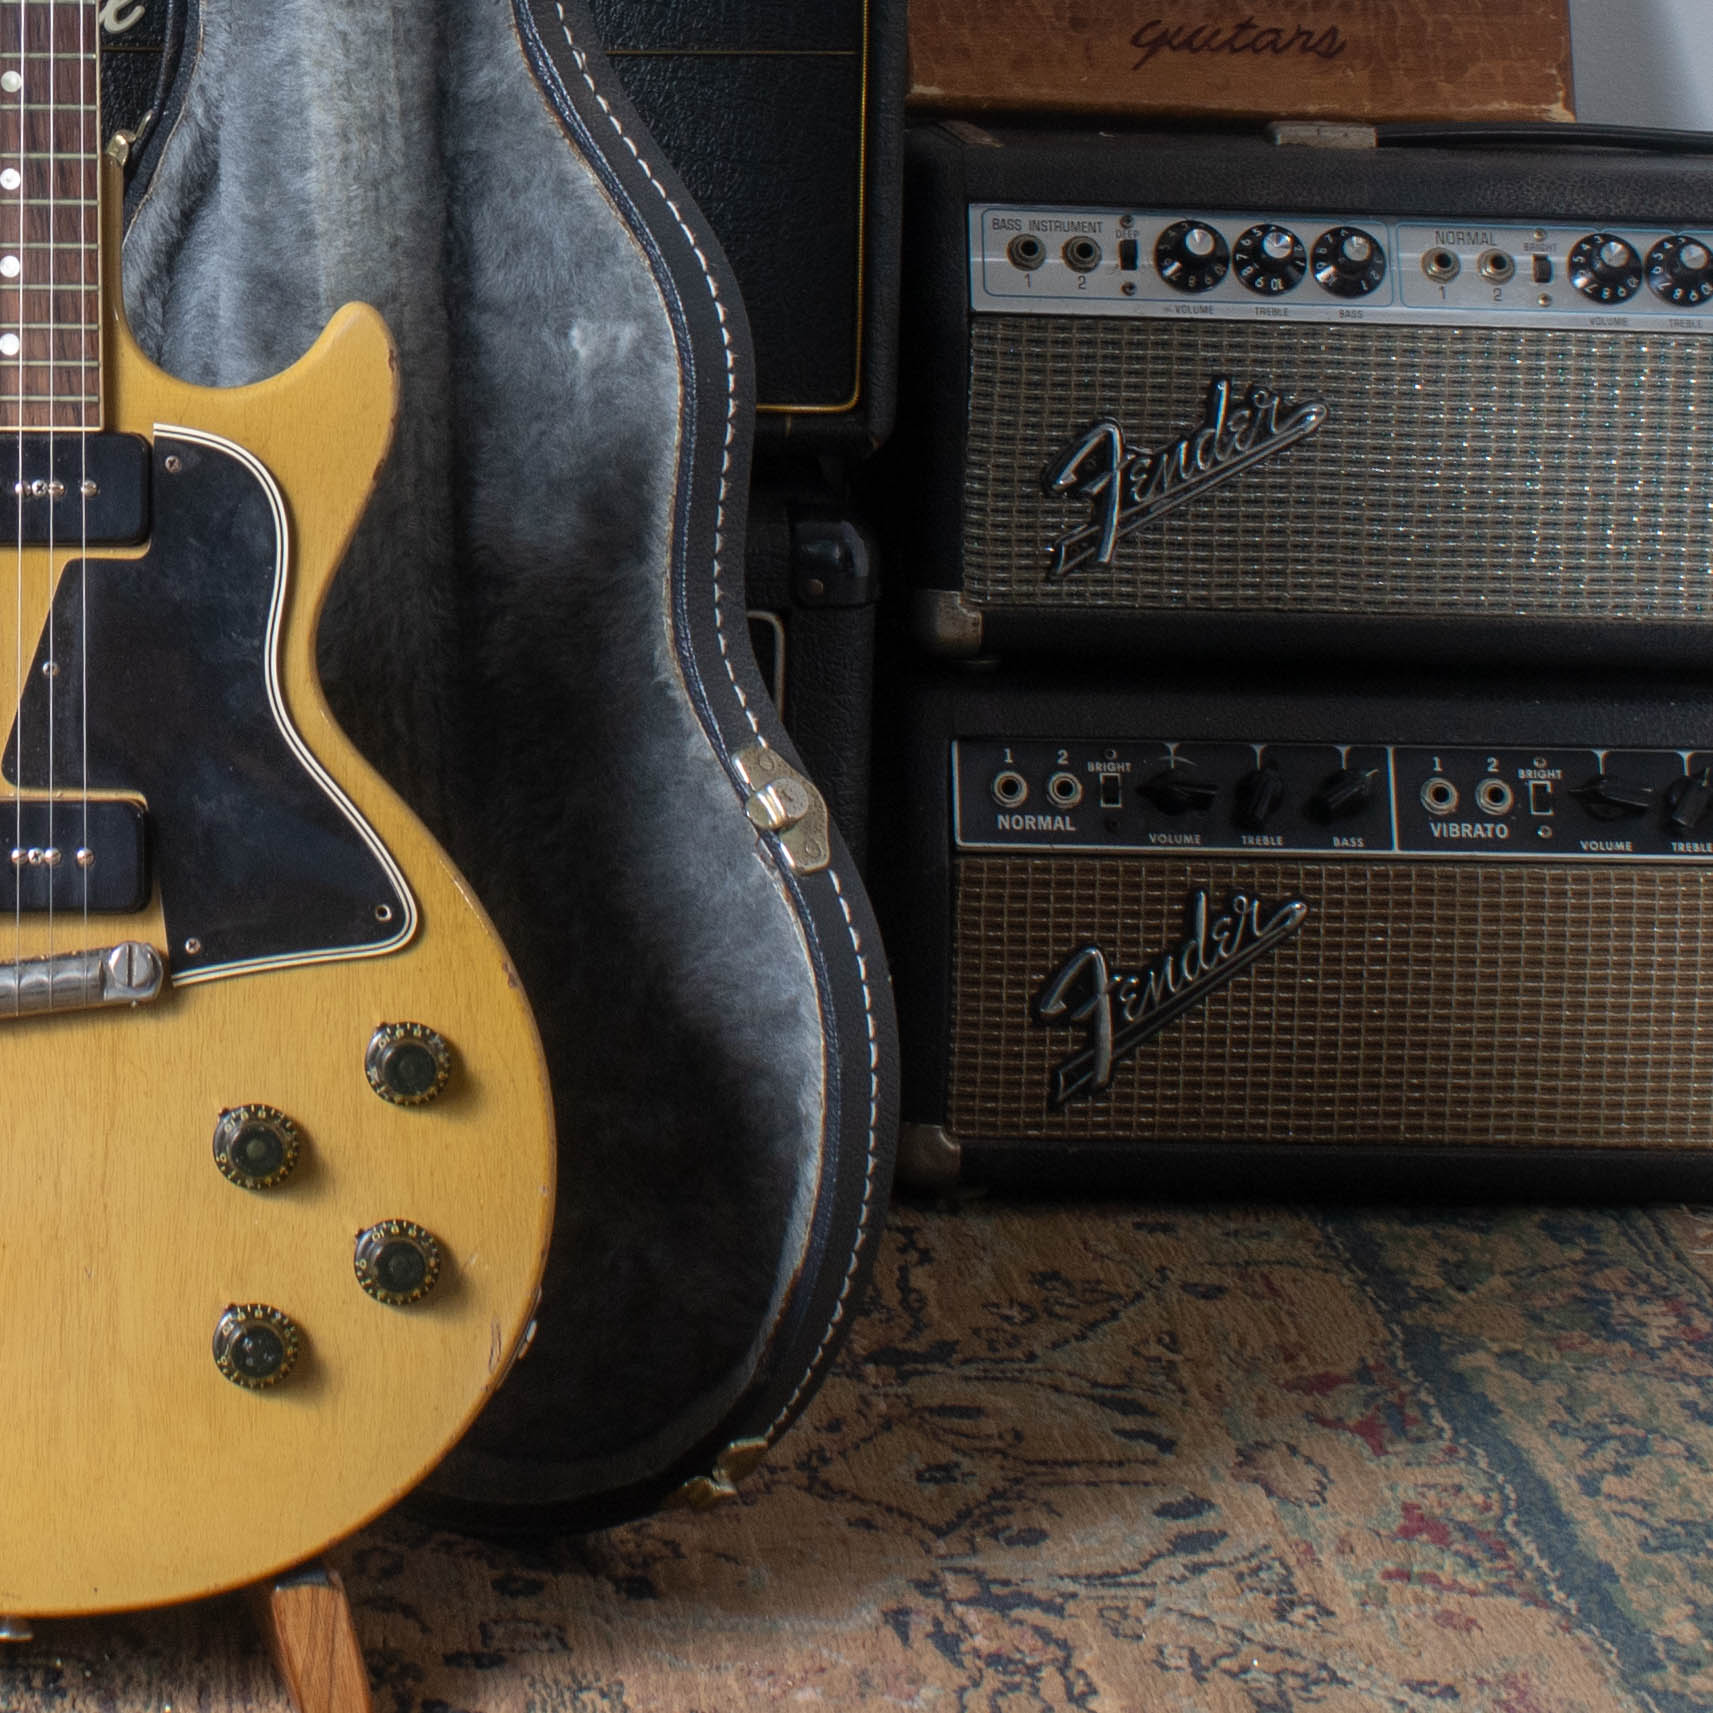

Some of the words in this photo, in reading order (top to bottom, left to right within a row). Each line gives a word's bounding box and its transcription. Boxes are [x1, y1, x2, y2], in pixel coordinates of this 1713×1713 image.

[1130, 15, 1347, 70] guitars
[992, 218, 1022, 231] BASS
[1029, 219, 1104, 233] INSTRUMENT
[1435, 230, 1497, 247] NORMAL
[1024, 273, 1031, 288] 1
[1077, 275, 1086, 290] 2
[1493, 288, 1502, 302] 2
[1174, 304, 1215, 315] VOLUME
[1052, 379, 1324, 572] Fender
[1004, 748, 1014, 764] 1
[1056, 749, 1069, 765] 2
[1432, 756, 1443, 772] 1
[1487, 757, 1500, 773] 2
[1087, 761, 1132, 773] BRIGHT
[1517, 768, 1563, 780] BRIGHT
[997, 813, 1076, 832] NORMAL
[1429, 822, 1510, 839] VIBRATO
[1148, 832, 1202, 845] VOLUME
[1241, 835, 1284, 847] TREBLE
[1332, 837, 1365, 848] BASS
[1579, 840, 1633, 853] VOLUME
[1040, 891, 1306, 1100] Fender
